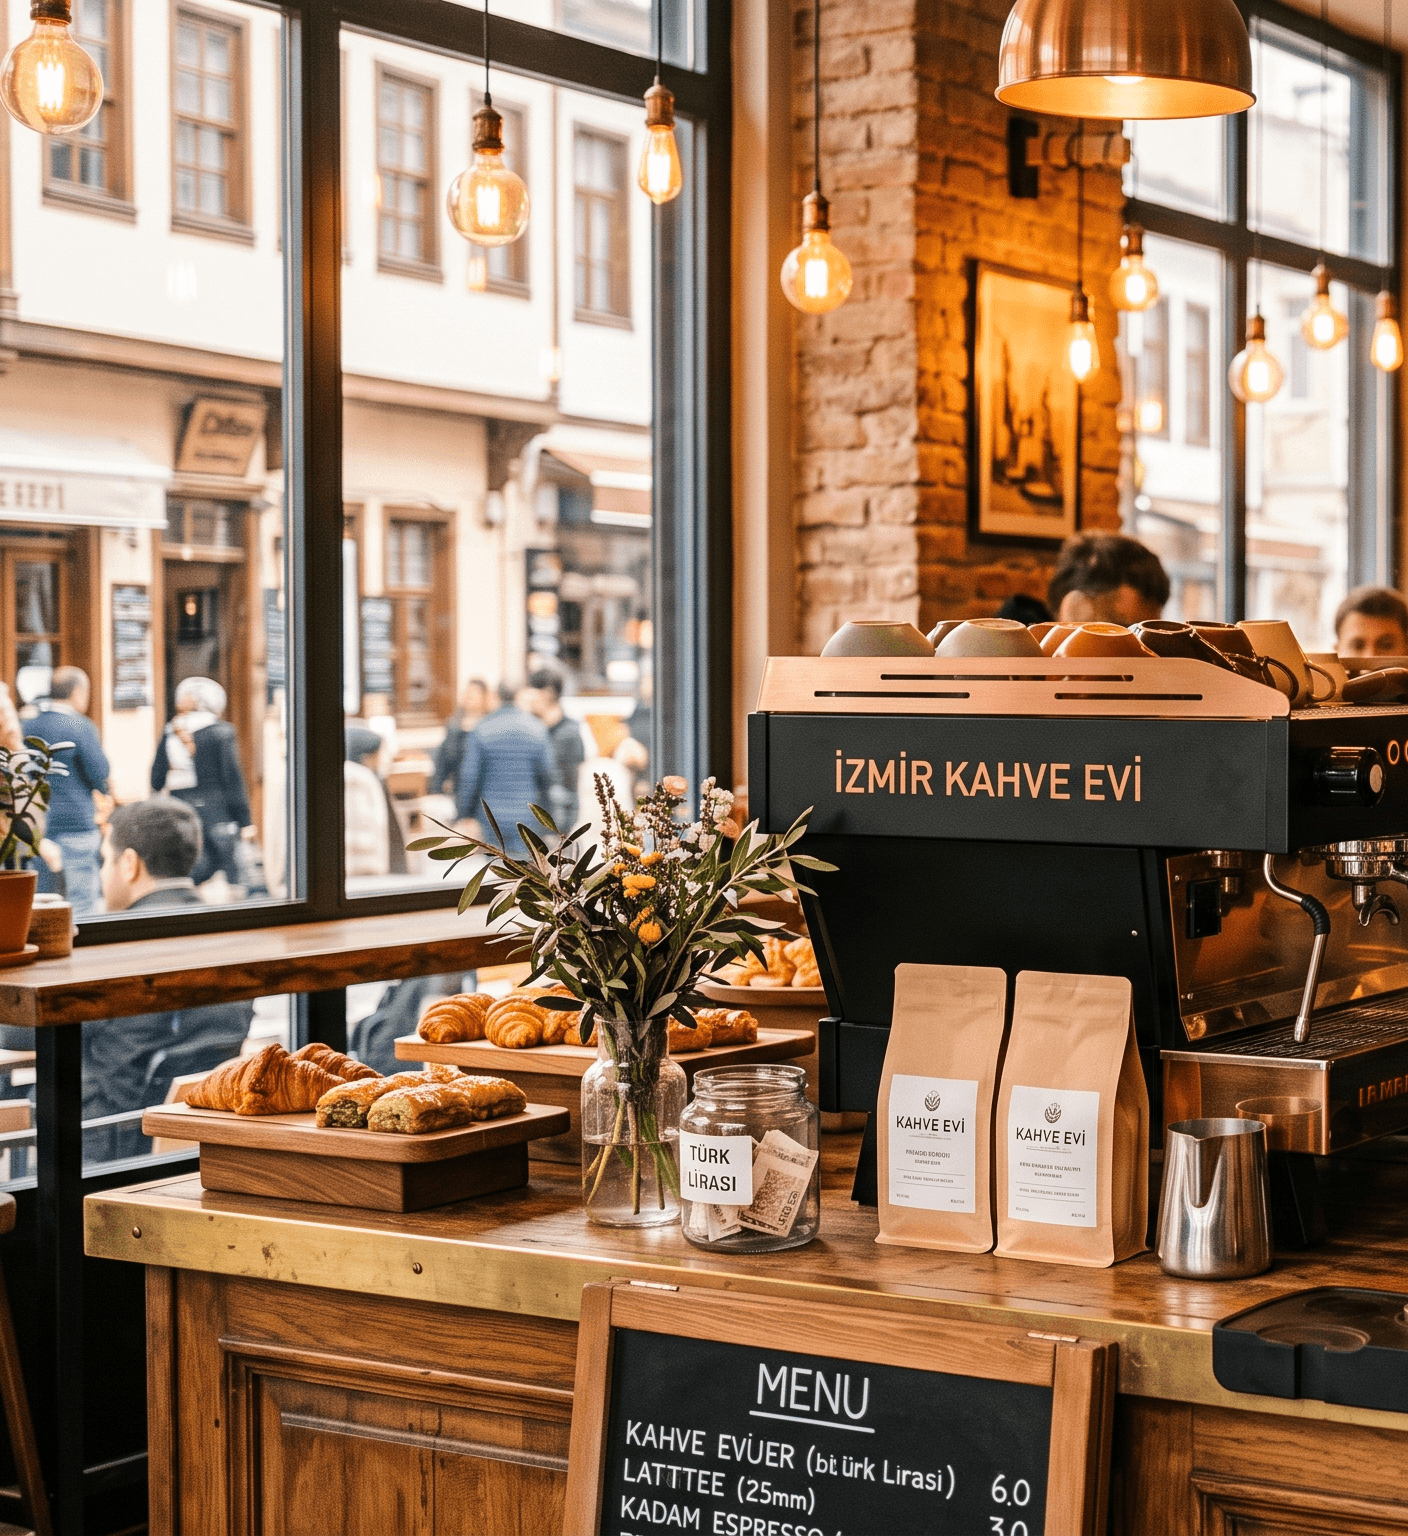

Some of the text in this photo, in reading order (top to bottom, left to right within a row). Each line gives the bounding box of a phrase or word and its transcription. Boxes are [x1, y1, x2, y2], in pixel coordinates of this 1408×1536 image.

[835, 749, 1141, 802] İZMİR KAHVE EVİ
[896, 1115, 965, 1134] KAHVE EVİ
[1016, 1127, 1086, 1147] KAHVE EVİ
[689, 1143, 731, 1165] TÜRK
[688, 1168, 737, 1192] LİRASI
[756, 1362, 870, 1420] MENU
[625, 1419, 707, 1456] KAHVE
[991, 1473, 1031, 1507] 6.0
[623, 1457, 726, 1497] LATTTEE
[737, 1475, 815, 1516] (25mm)
[620, 1494, 701, 1531] KADAM
